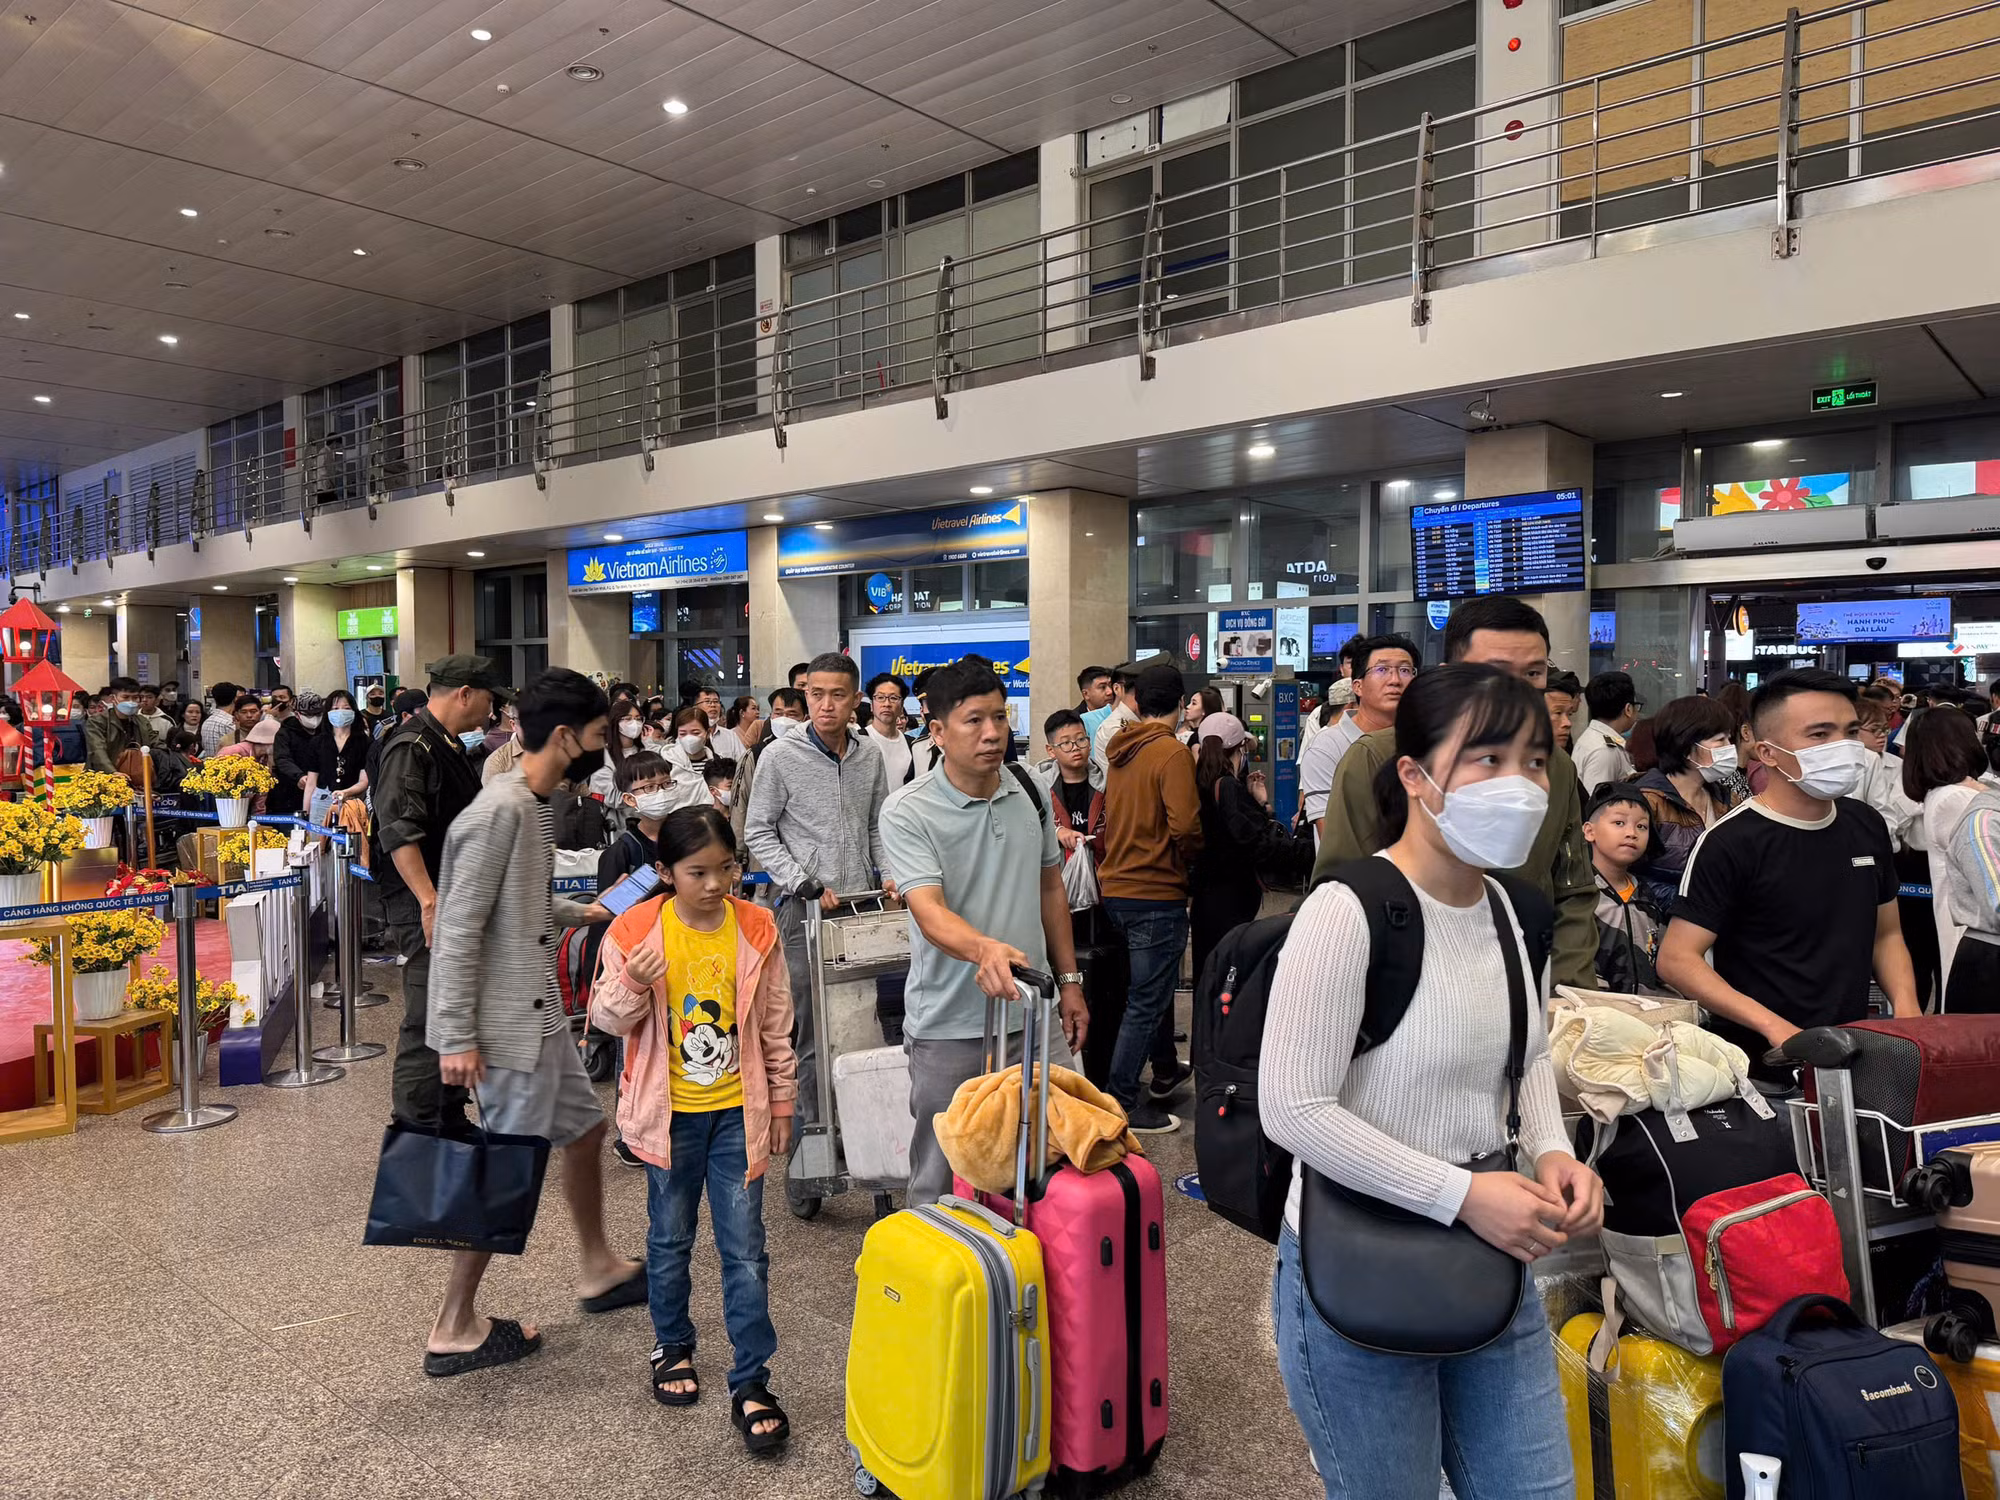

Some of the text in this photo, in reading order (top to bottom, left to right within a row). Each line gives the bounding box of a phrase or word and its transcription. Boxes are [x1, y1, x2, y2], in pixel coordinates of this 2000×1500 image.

[1462, 501, 1500, 511] Departures
[1556, 492, 1577, 500] 05:01
[932, 513, 1002, 530] Vietravel Airlines
[607, 555, 708, 579] Vietnam Airlines
[1278, 693, 1294, 703] BXC
[217, 884, 247, 895] TIA
[278, 878, 292, 886] TAN
[553, 879, 582, 890] TIA
[3, 908, 31, 918] CẢNG
[32, 903, 60, 915] HÀNG
[61, 901, 94, 912] KHÔNG
[97, 898, 121, 909] QUỐC
[123, 896, 134, 906] TẾ
[136, 894, 153, 904] TÂN
[1860, 1381, 1913, 1402] Sacombank
